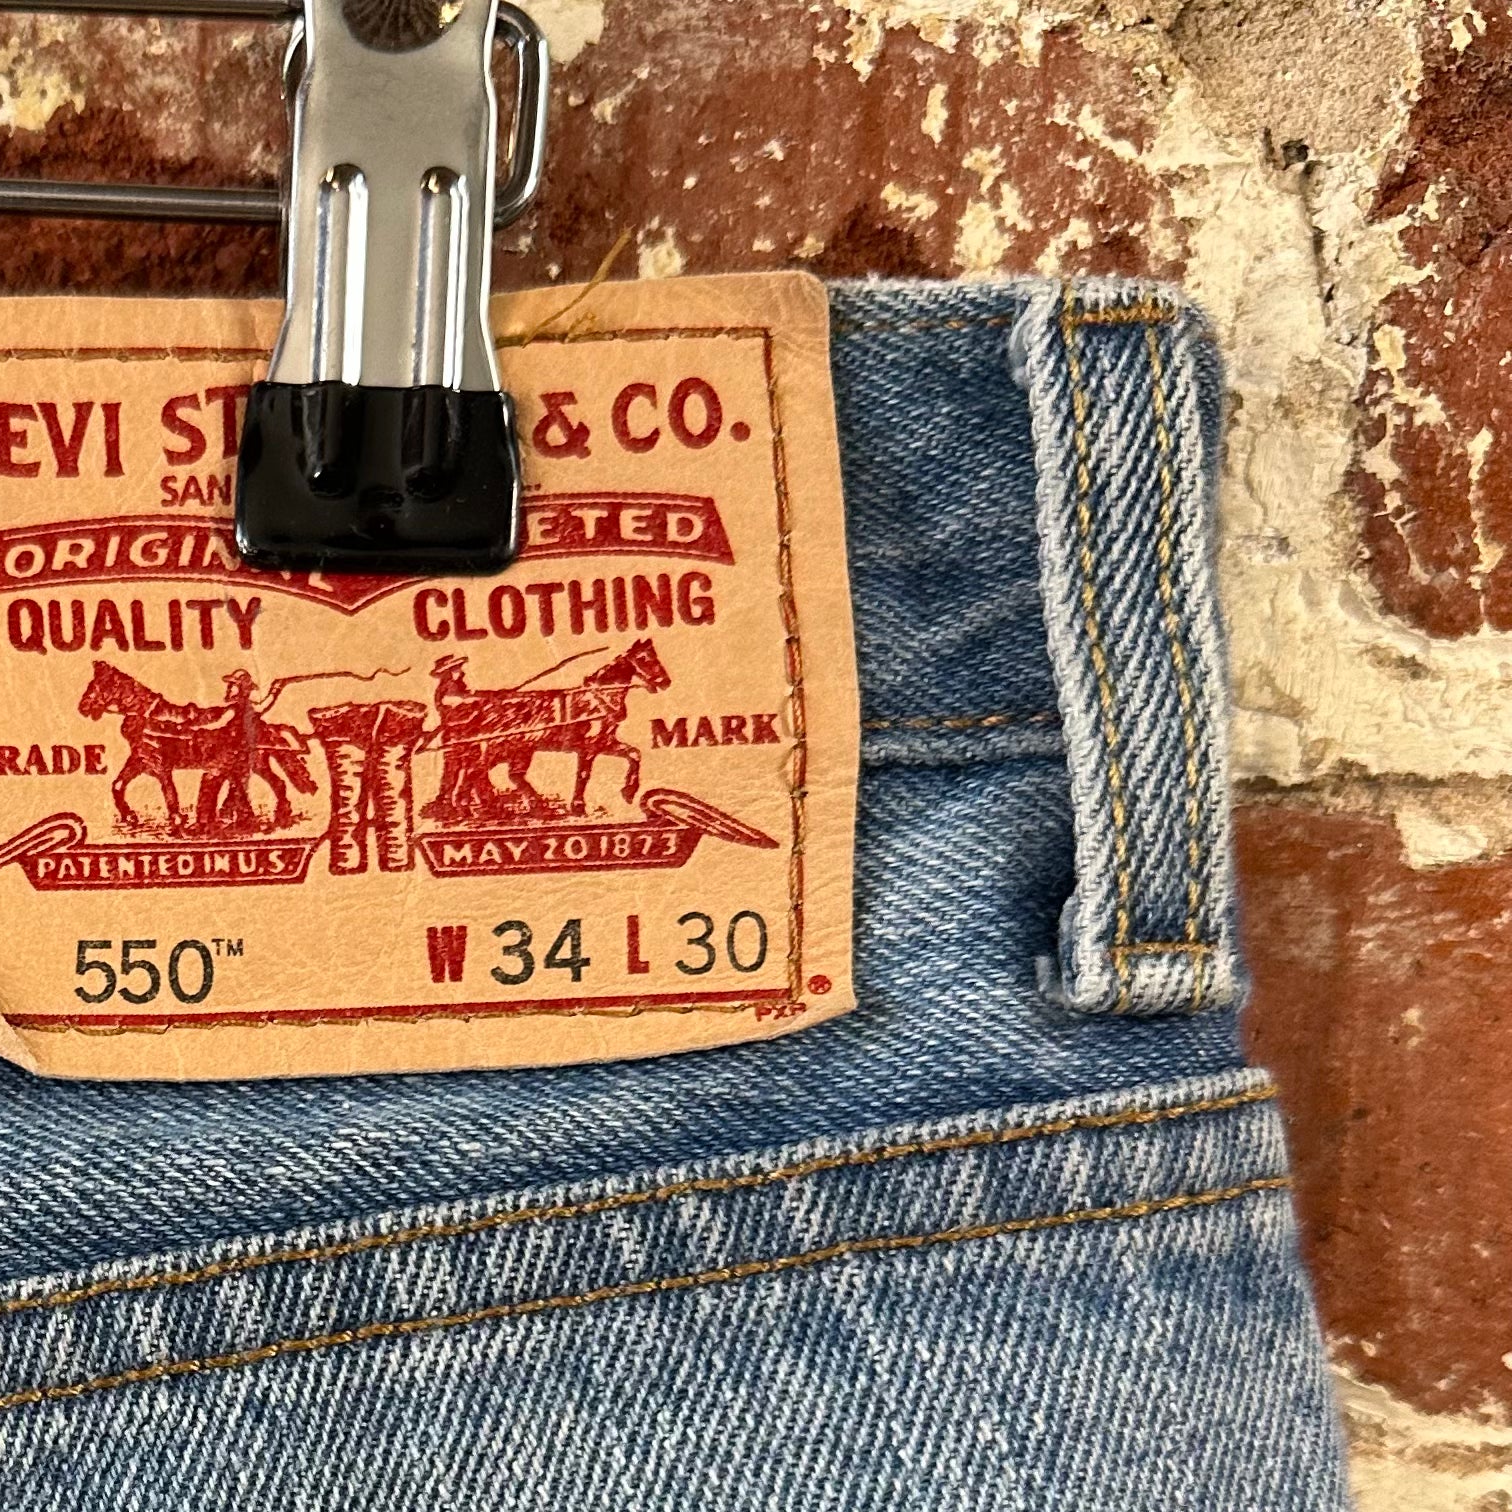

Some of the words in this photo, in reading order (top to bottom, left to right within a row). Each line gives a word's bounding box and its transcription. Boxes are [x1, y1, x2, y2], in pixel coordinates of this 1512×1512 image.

[532, 391, 592, 459] &
[611, 377, 751, 454] CO.
[161, 475, 232, 507] SAN
[525, 507, 705, 546] ETED
[7, 597, 262, 655] QUALITY
[413, 571, 716, 642] CLOTHING
[651, 713, 781, 750] MARK
[37, 854, 196, 880] PATENTED
[443, 839, 527, 866] MAY
[543, 836, 586, 861] 20
[598, 833, 678, 858] 1873
[426, 925, 468, 983] W
[490, 918, 591, 986] 34
[626, 914, 650, 975] L
[675, 910, 768, 976] 30
